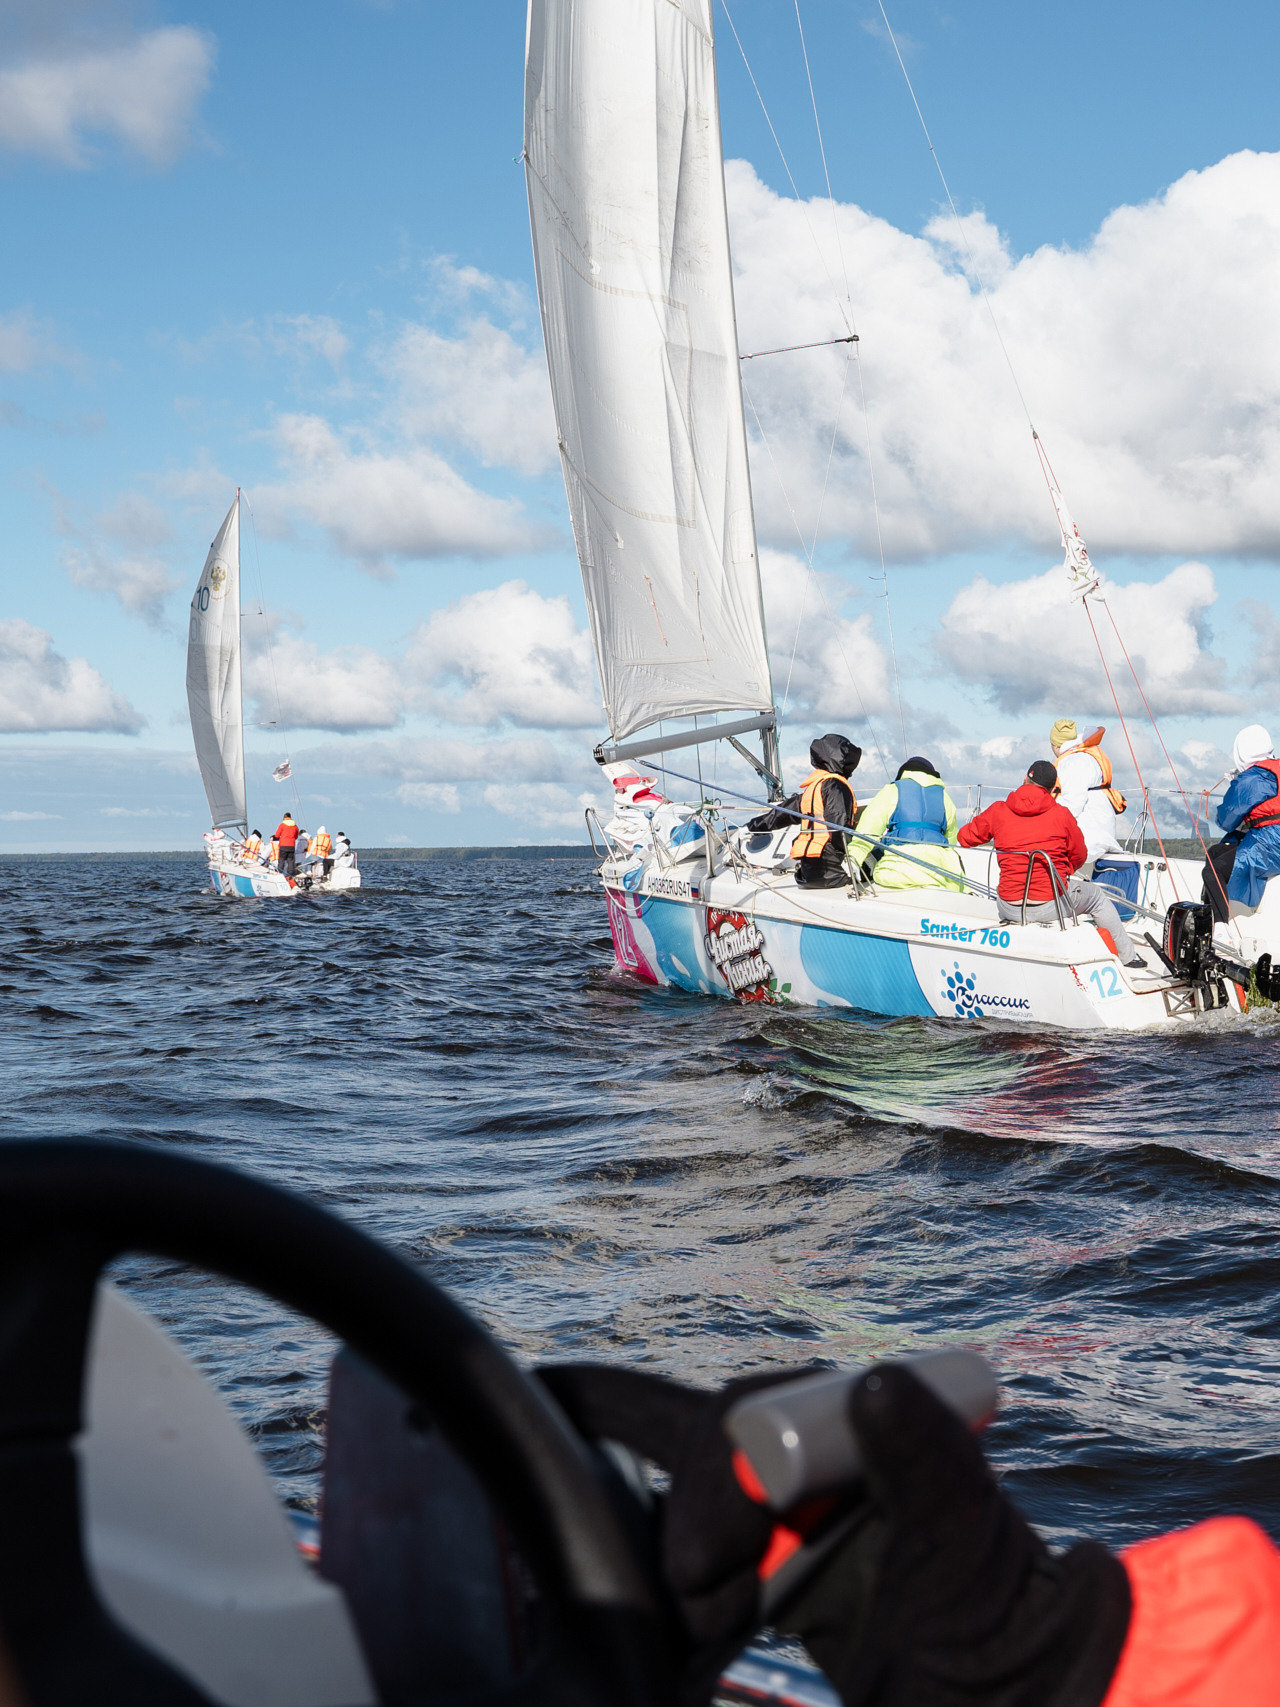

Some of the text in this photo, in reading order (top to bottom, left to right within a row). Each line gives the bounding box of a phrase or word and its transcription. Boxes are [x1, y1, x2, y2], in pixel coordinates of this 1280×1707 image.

[197, 586, 210, 611] 10
[920, 918, 1010, 948] Santer 760
[1090, 966, 1123, 998] 12
